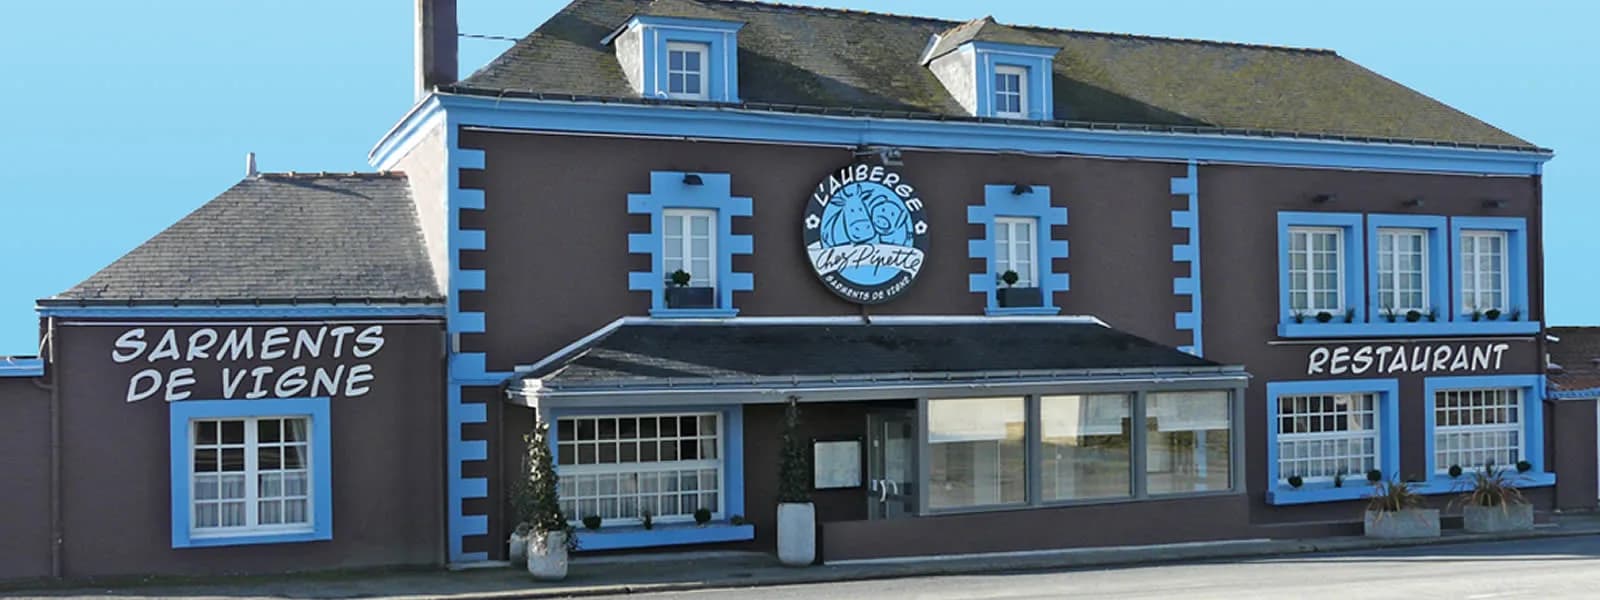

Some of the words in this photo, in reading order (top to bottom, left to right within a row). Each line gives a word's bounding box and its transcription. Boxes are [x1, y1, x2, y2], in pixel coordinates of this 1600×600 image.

[814, 164, 923, 212] L'AUBERGE
[815, 248, 855, 273] Chez
[852, 243, 921, 276] Pipette
[825, 275, 869, 300] SARMENTS
[112, 325, 385, 363] SARMENTS
[1307, 343, 1509, 375] RESTAURANT
[127, 367, 196, 402] DE
[222, 364, 374, 399] VIGNE
